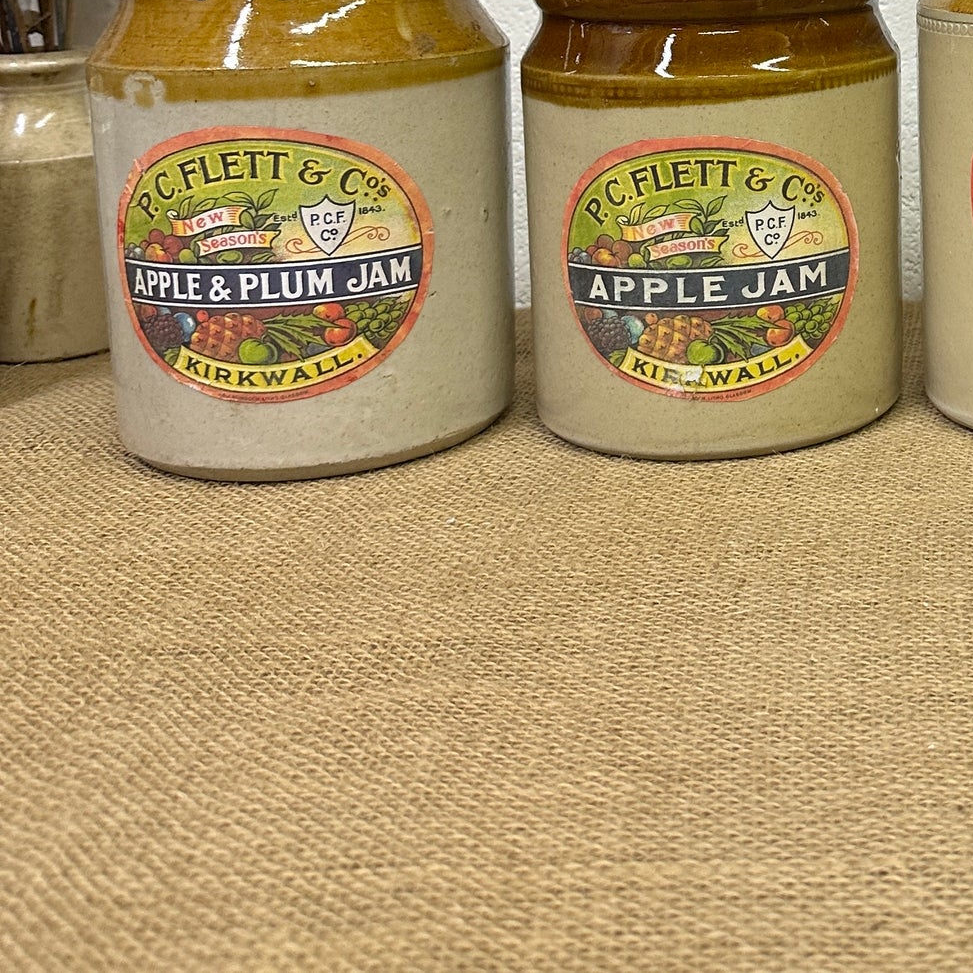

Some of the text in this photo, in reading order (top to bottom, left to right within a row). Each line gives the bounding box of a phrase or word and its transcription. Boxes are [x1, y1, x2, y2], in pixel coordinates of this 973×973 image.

[299, 159, 332, 185] &
[745, 167, 776, 192] &
[183, 210, 224, 233] New
[634, 218, 676, 241] New
[201, 231, 267, 253] Season's
[652, 238, 716, 257] Season's
[134, 255, 412, 302] APPLE & PLUM JAM
[589, 261, 827, 304] APPLE JAM
